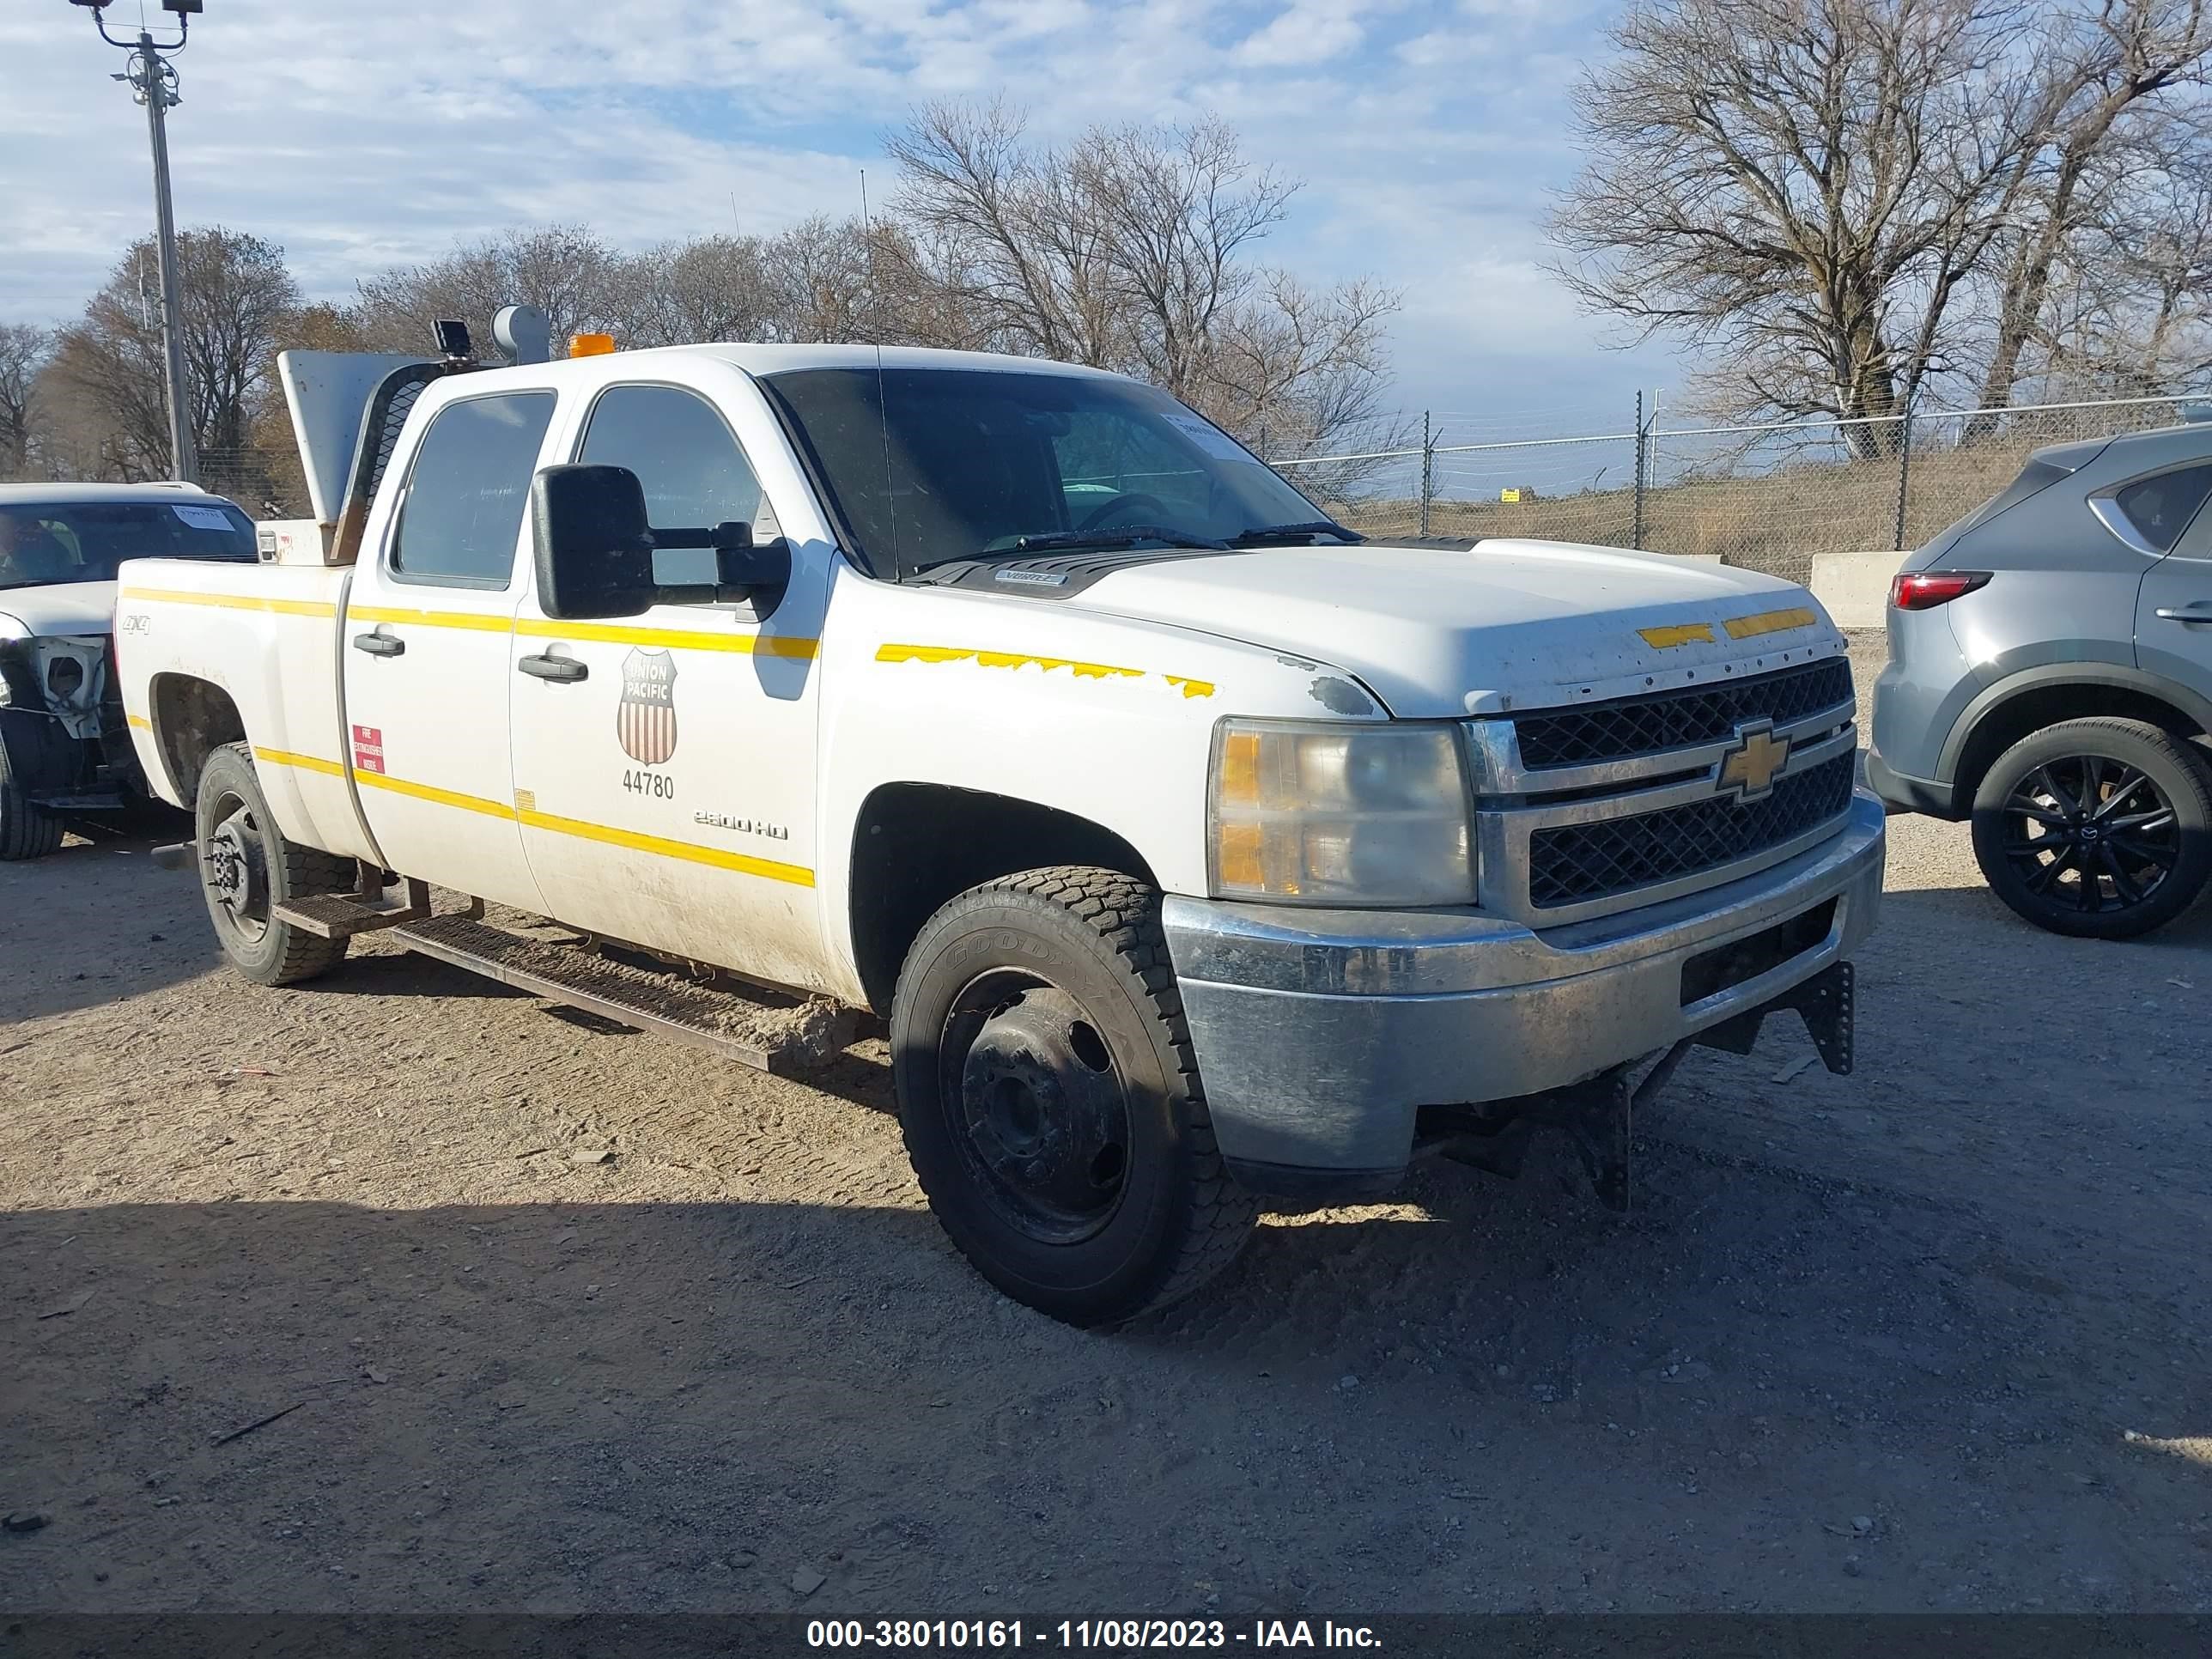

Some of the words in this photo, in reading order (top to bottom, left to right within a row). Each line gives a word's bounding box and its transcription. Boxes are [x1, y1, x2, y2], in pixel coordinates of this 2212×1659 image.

[631, 662, 667, 681] UNION
[627, 681, 669, 701] PACIFIC
[623, 769, 674, 799] 44780
[694, 809, 752, 833] 2500
[755, 819, 789, 841] HD
